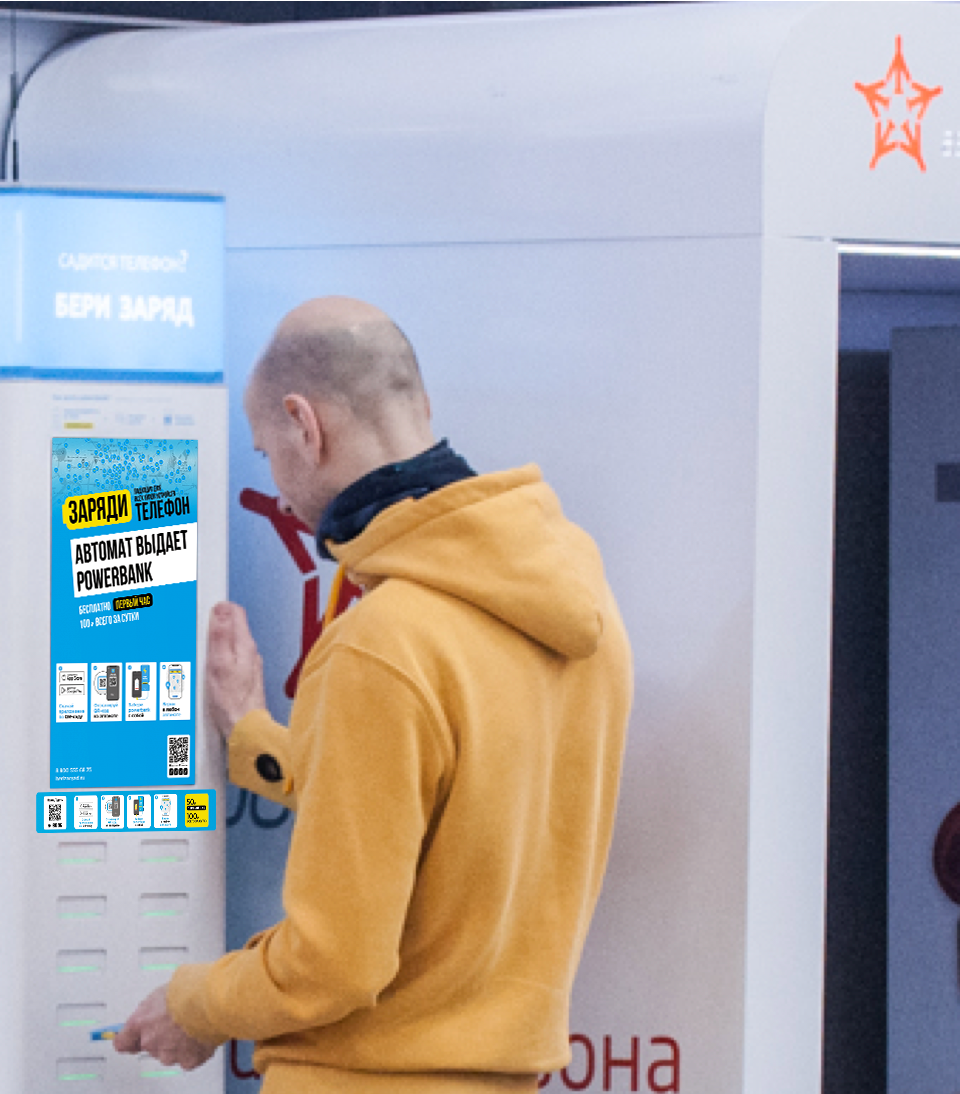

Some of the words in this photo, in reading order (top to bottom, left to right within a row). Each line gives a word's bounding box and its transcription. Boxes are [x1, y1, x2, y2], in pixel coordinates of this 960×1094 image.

[58, 252, 118, 271] САДИТСЯ
[55, 292, 111, 319] БЕРИ
[119, 294, 195, 327] ЗАРЯД
[68, 494, 129, 524] ЗАРЯДИ
[135, 496, 190, 521] ТЕЛЕФОН
[75, 537, 132, 565] АВТОМАТ
[136, 529, 188, 557] ВЫДАЕТ
[77, 561, 153, 592] POWERBANK
[78, 601, 111, 615] БЕСПЛАТНО
[115, 596, 139, 609] ПЕРВЫЙ
[139, 596, 151, 605] ЧАС
[538, 1033, 680, 1094] она
